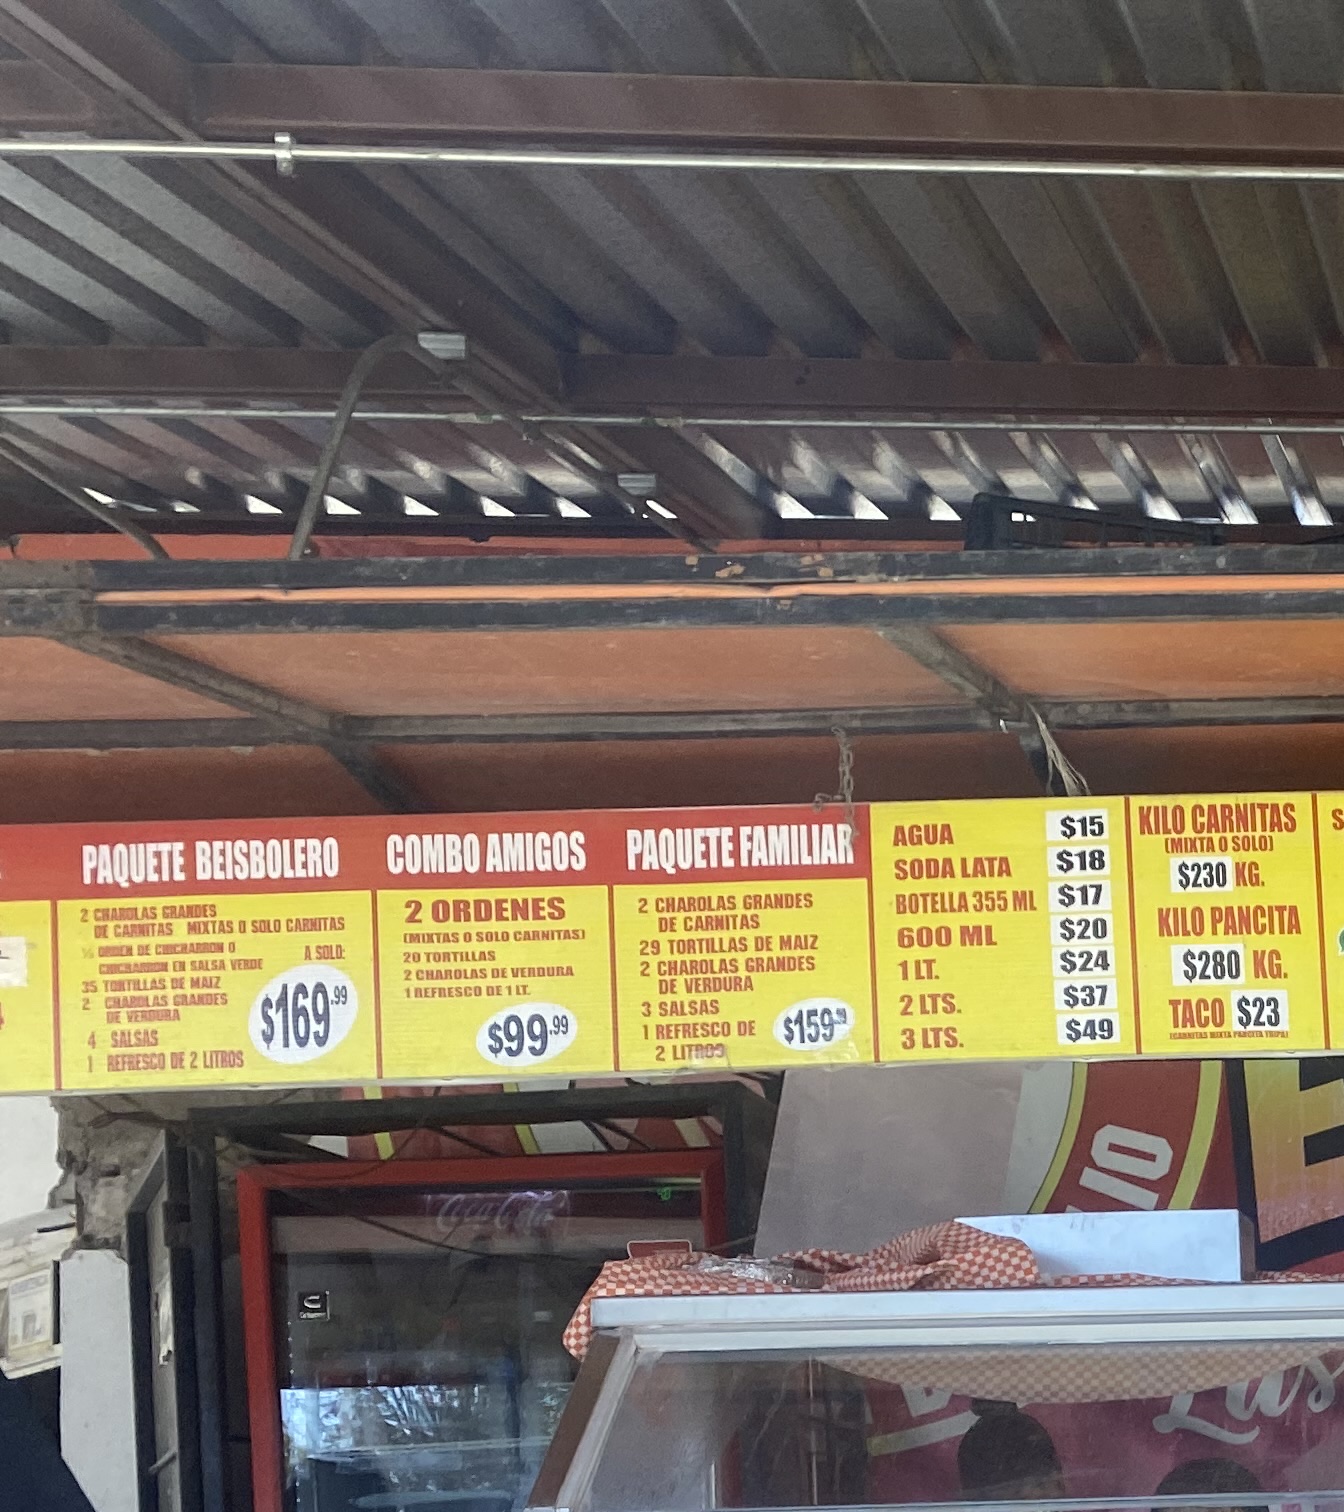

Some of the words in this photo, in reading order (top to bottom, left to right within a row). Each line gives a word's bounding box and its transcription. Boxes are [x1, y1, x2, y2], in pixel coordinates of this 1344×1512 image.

[1139, 805, 1185, 835] KILO
[1191, 803, 1296, 834] CARNITAS
[893, 823, 954, 847] AGUA
[1060, 815, 1104, 839] $15
[387, 833, 480, 874] COMBO
[486, 831, 586, 872] AMIGOS
[627, 827, 734, 874] PAQUETE
[739, 824, 854, 867] FAMILIAR
[1165, 837, 1214, 853] (MIXTA
[1219, 837, 1227, 852] O
[1232, 835, 1274, 852] SOLO)
[83, 841, 186, 888] PAQUETE
[196, 837, 339, 880] BEISBOLERO
[894, 857, 955, 880] SODA
[960, 856, 1012, 878] LATA
[1056, 849, 1105, 873] $18
[1178, 861, 1227, 890] $230
[1235, 861, 1265, 886] KG.
[638, 898, 648, 913] 2
[655, 895, 736, 912] CHAROLAS
[743, 893, 813, 909] GRANDES
[896, 892, 969, 915] BOTELLA
[972, 890, 1007, 912] 355
[1013, 890, 1036, 911] ML
[1058, 884, 1103, 907] $17
[163, 905, 216, 918] GRANDES
[405, 900, 422, 923] 2
[432, 897, 566, 923] ORDENES
[114, 923, 173, 937] CARNITAS
[188, 921, 233, 934] MIXTAS
[251, 920, 281, 933] SOLO
[286, 917, 345, 932] CARNITAS
[658, 917, 676, 932] DE
[684, 914, 760, 931] CARNITAS
[1158, 907, 1204, 937] KILO
[1210, 905, 1301, 935] PANCITA
[463, 932, 472, 942] O
[476, 931, 509, 942] SOLO
[897, 927, 952, 948] 600
[960, 925, 997, 947] ML
[1060, 918, 1107, 942] $20
[138, 944, 150, 956] DE
[305, 946, 310, 960] A
[316, 945, 345, 960] SOLO:
[640, 940, 660, 955] 29
[668, 937, 747, 955] TORTILLAS
[755, 936, 772, 951] DE
[779, 935, 818, 950] MAIZ
[191, 960, 226, 972] SALSA
[231, 959, 262, 970] VERDE
[403, 952, 420, 962] 20
[424, 951, 496, 962] TORTILLAS
[640, 962, 650, 976] 2
[657, 958, 738, 975] CHAROLAS
[745, 956, 815, 972] GRANDES
[898, 960, 908, 981] 1
[914, 959, 939, 980] LT.
[1060, 950, 1109, 974] $24
[1183, 949, 1240, 983] $280
[1253, 950, 1288, 979] KG.
[404, 970, 412, 980] 2
[416, 968, 487, 980] CHAROLAS
[491, 968, 507, 978] DE
[511, 966, 574, 977] VERDURA
[82, 981, 97, 993] 35
[103, 978, 166, 992] TORTILLAS
[171, 978, 184, 989] DE
[191, 977, 221, 989] MAIZ
[414, 986, 482, 998] REFRESCO
[486, 986, 502, 996] DE
[658, 979, 676, 994] DE
[685, 976, 753, 993] VERDURA
[173, 993, 228, 1006] GRANDES
[641, 1002, 651, 1017] 3
[658, 1000, 719, 1017] SALSAS
[900, 995, 913, 1016] 2
[920, 993, 961, 1015] LTS.
[1063, 984, 1108, 1008] $37
[107, 1012, 121, 1024] DE
[262, 982, 347, 1049] $169.99
[1169, 998, 1224, 1028] TACO
[1237, 996, 1280, 1029] $23
[111, 1030, 158, 1047] SALSAS
[488, 1014, 568, 1058] $99.99
[656, 1022, 730, 1039] REFRESCO
[738, 1020, 755, 1036] DE
[901, 1028, 915, 1050] 3
[922, 1027, 964, 1049] LTS.
[1065, 1018, 1113, 1042] $49
[107, 1053, 165, 1072] REFRESCO
[171, 1053, 185, 1070] DE
[203, 1051, 244, 1069] LITROS
[656, 1046, 665, 1061] 2
